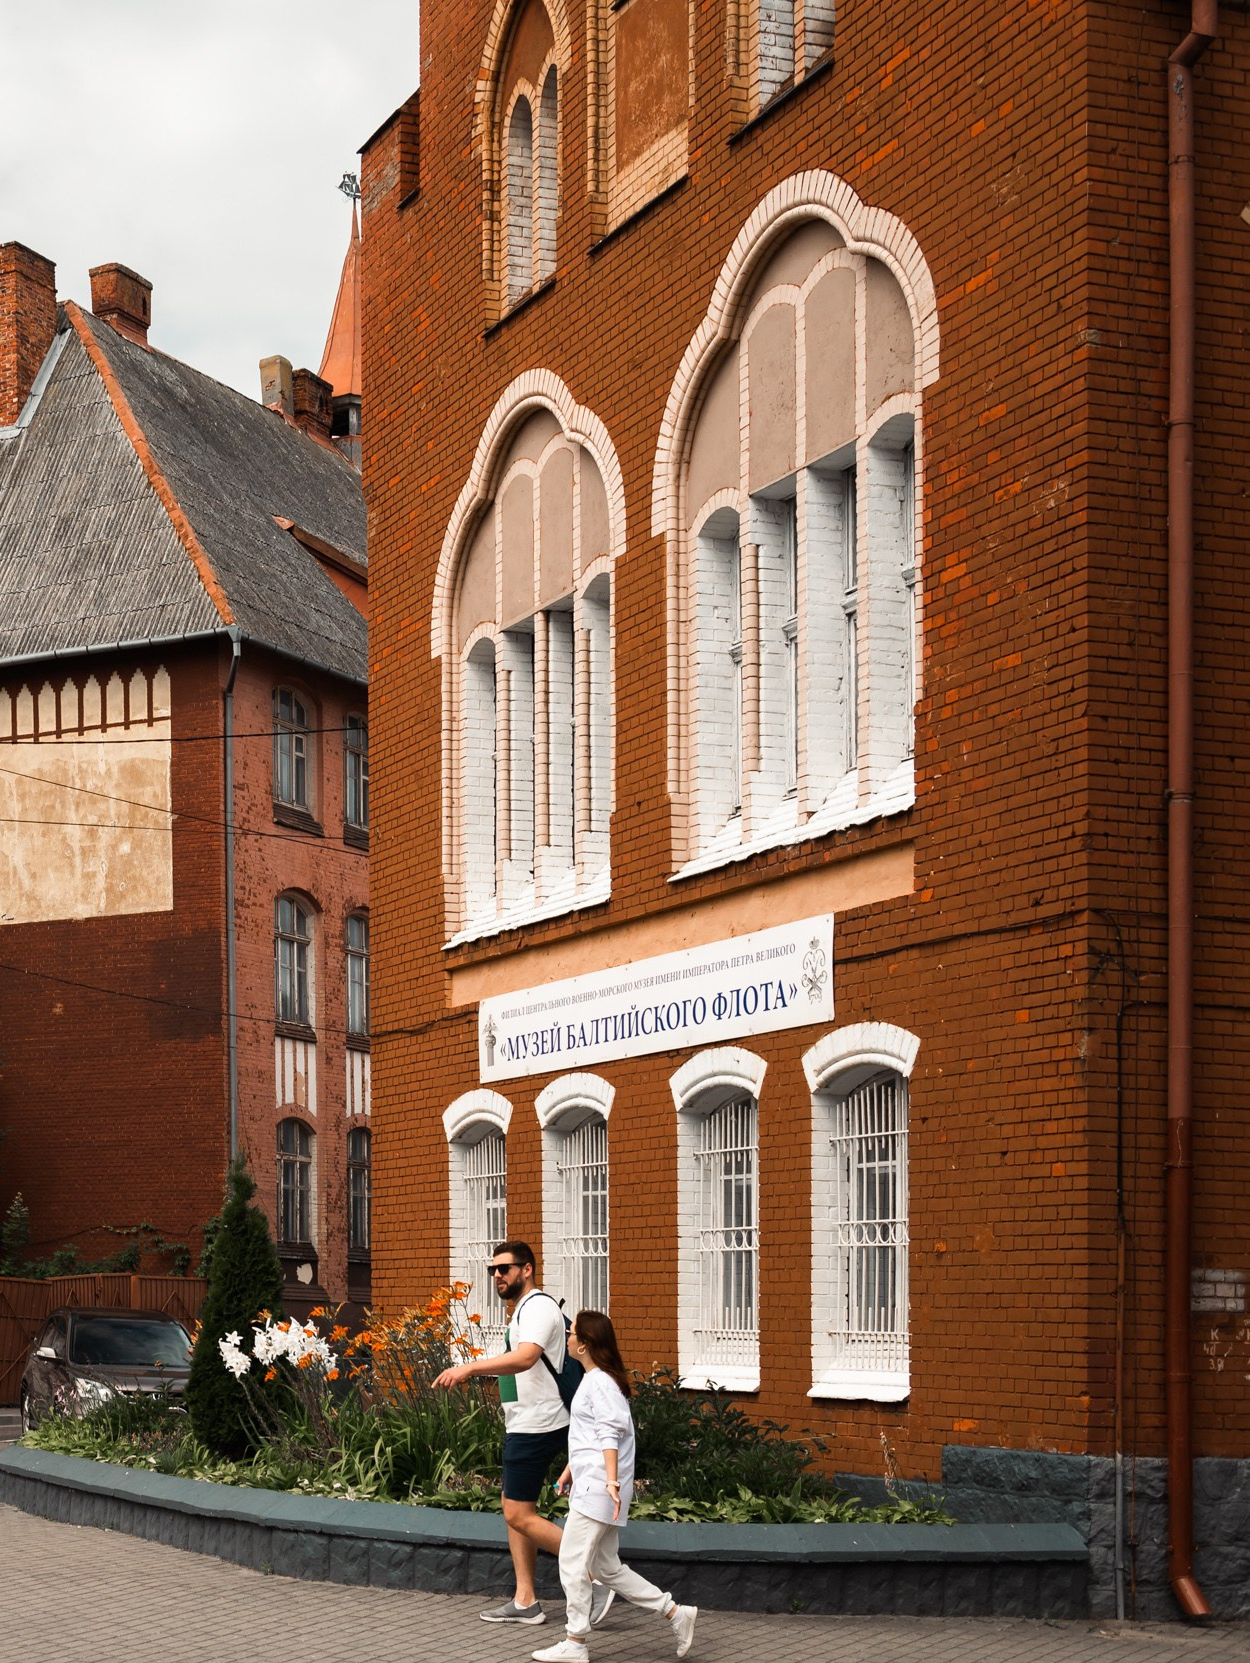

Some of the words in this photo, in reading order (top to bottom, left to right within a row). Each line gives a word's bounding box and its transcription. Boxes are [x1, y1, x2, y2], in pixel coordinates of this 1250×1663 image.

[500, 1007, 525, 1020] ФИЛИАЛ
[526, 997, 571, 1015] ЦЕНТРАЛЬНОГО
[571, 982, 633, 1005] ВОЕННО-МОРСКОГО
[633, 976, 654, 991] МУЗЕЯ
[655, 970, 681, 985] ИМЕНИ
[682, 960, 729, 978] ИМПЕРАТОРА
[730, 953, 754, 968] ПЕТРА
[755, 943, 796, 962] ВЕЛИКОГО
[500, 1021, 562, 1061] «МУЗЕЙ
[566, 996, 707, 1050] БАЛТИЙСКОГО
[712, 979, 798, 1021] ФЛОТА»
